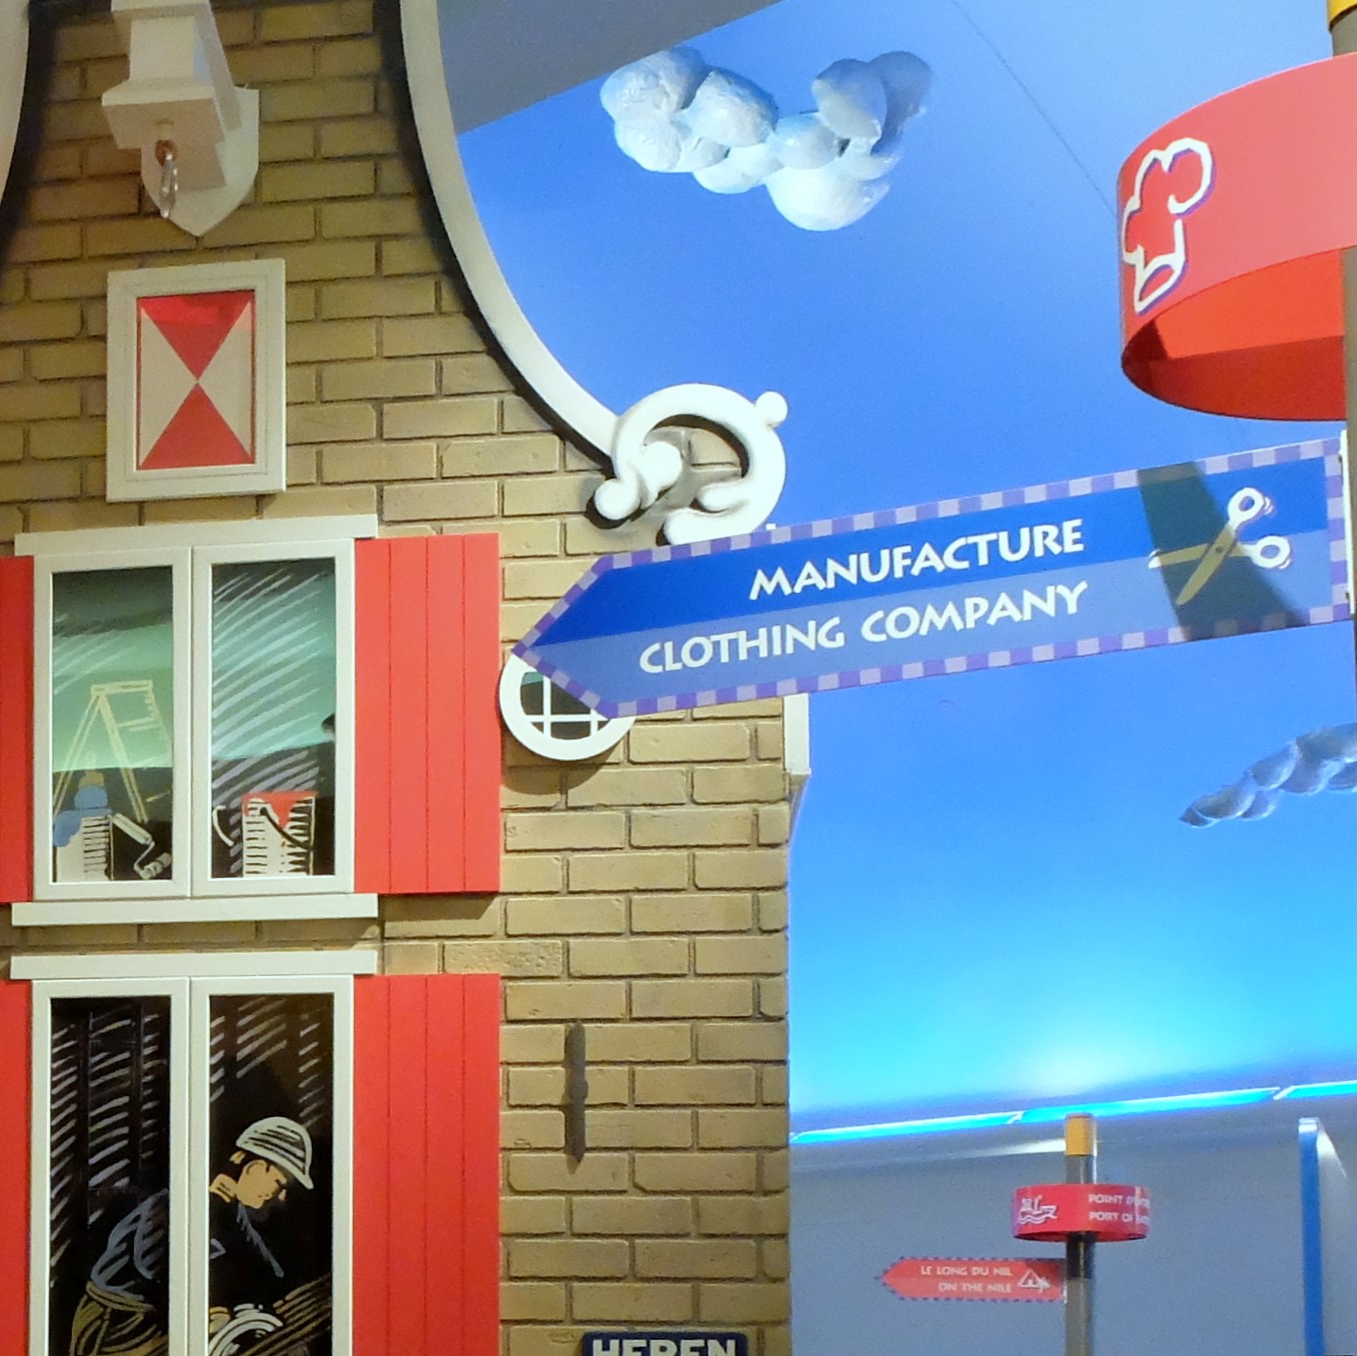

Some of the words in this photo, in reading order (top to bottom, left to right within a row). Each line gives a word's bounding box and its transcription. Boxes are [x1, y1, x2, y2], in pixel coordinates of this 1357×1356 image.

[749, 519, 1085, 601] MANUFACTURE
[639, 615, 846, 675] CLOTHING
[859, 580, 1089, 645] COMPANY
[920, 1265, 933, 1276] LE
[936, 1265, 968, 1276] LONG
[971, 1266, 990, 1276] DU
[993, 1266, 1013, 1277] NIL
[938, 1281, 958, 1292] ON
[961, 1282, 983, 1293] THE
[987, 1282, 1013, 1294] NILE
